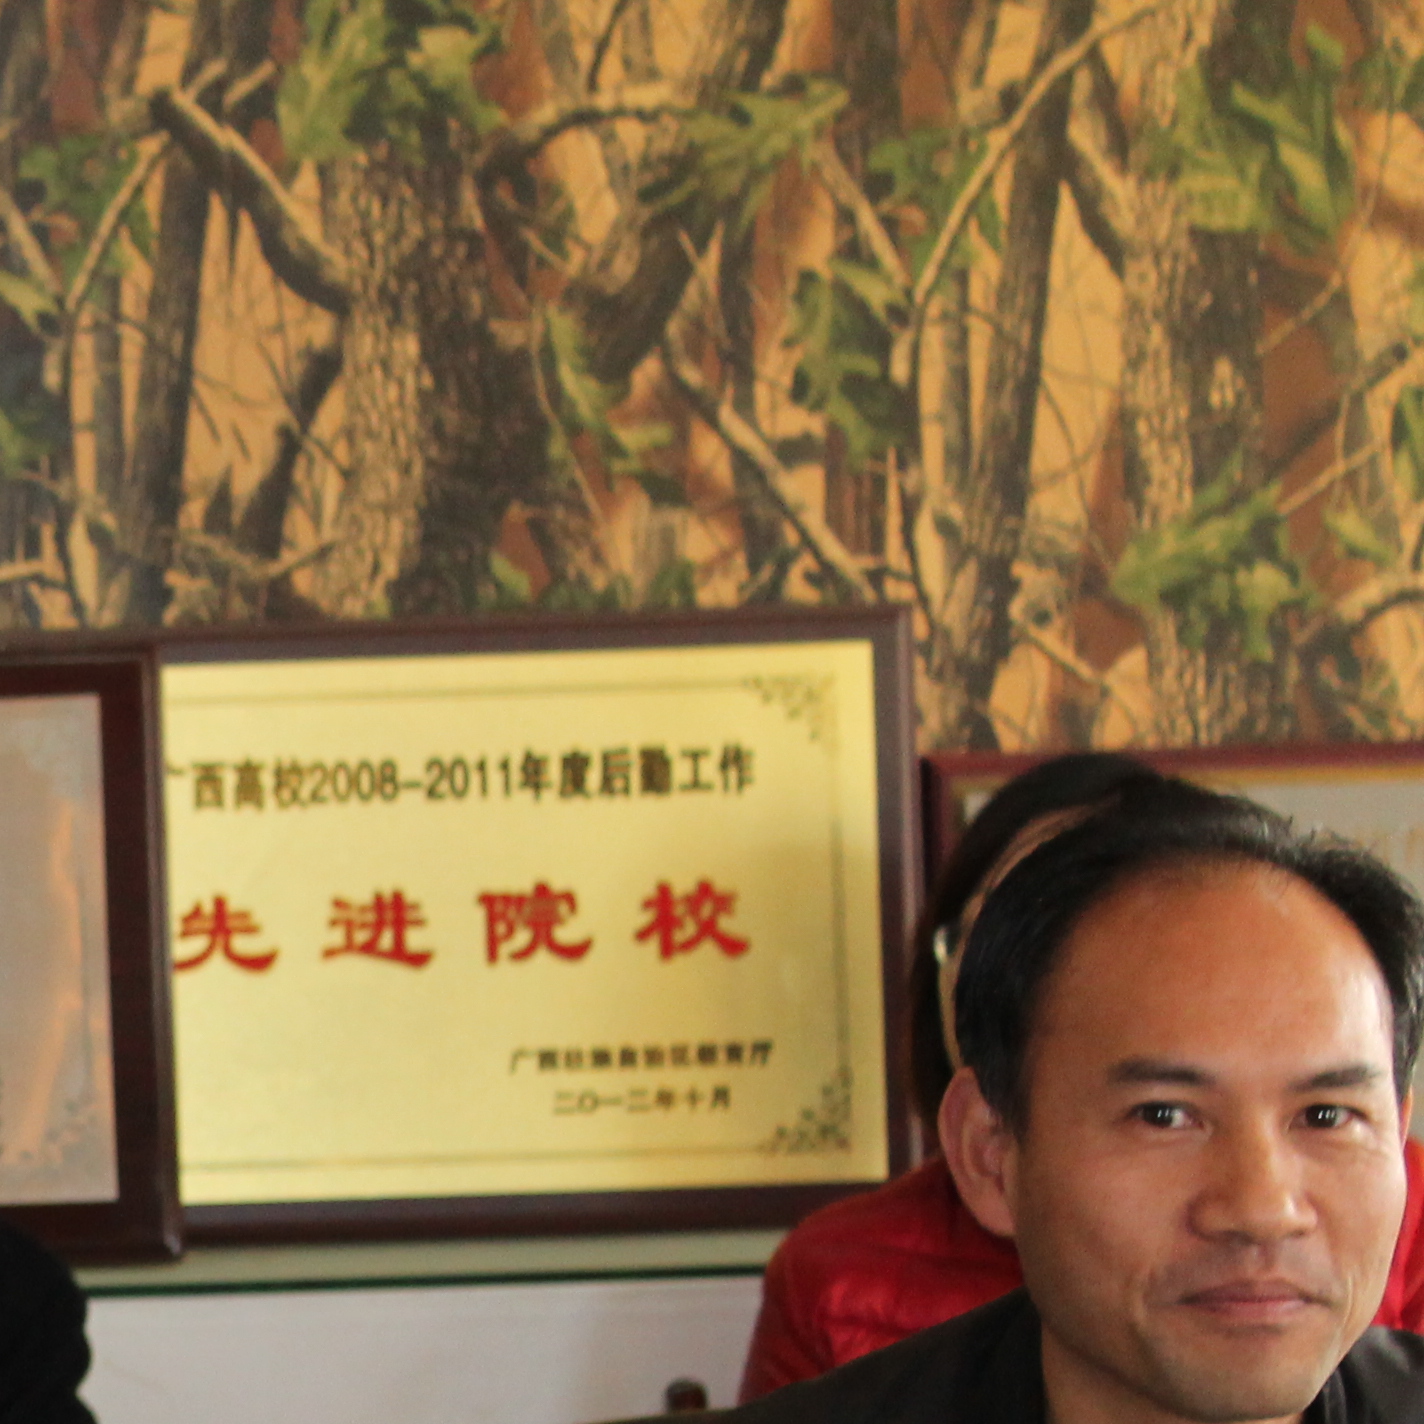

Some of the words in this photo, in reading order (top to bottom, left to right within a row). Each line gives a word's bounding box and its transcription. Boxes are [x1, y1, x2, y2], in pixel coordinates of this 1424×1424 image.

[165, 743, 756, 812] 西高校2008-2011年度后勤工作
[171, 878, 750, 976] 先进院校
